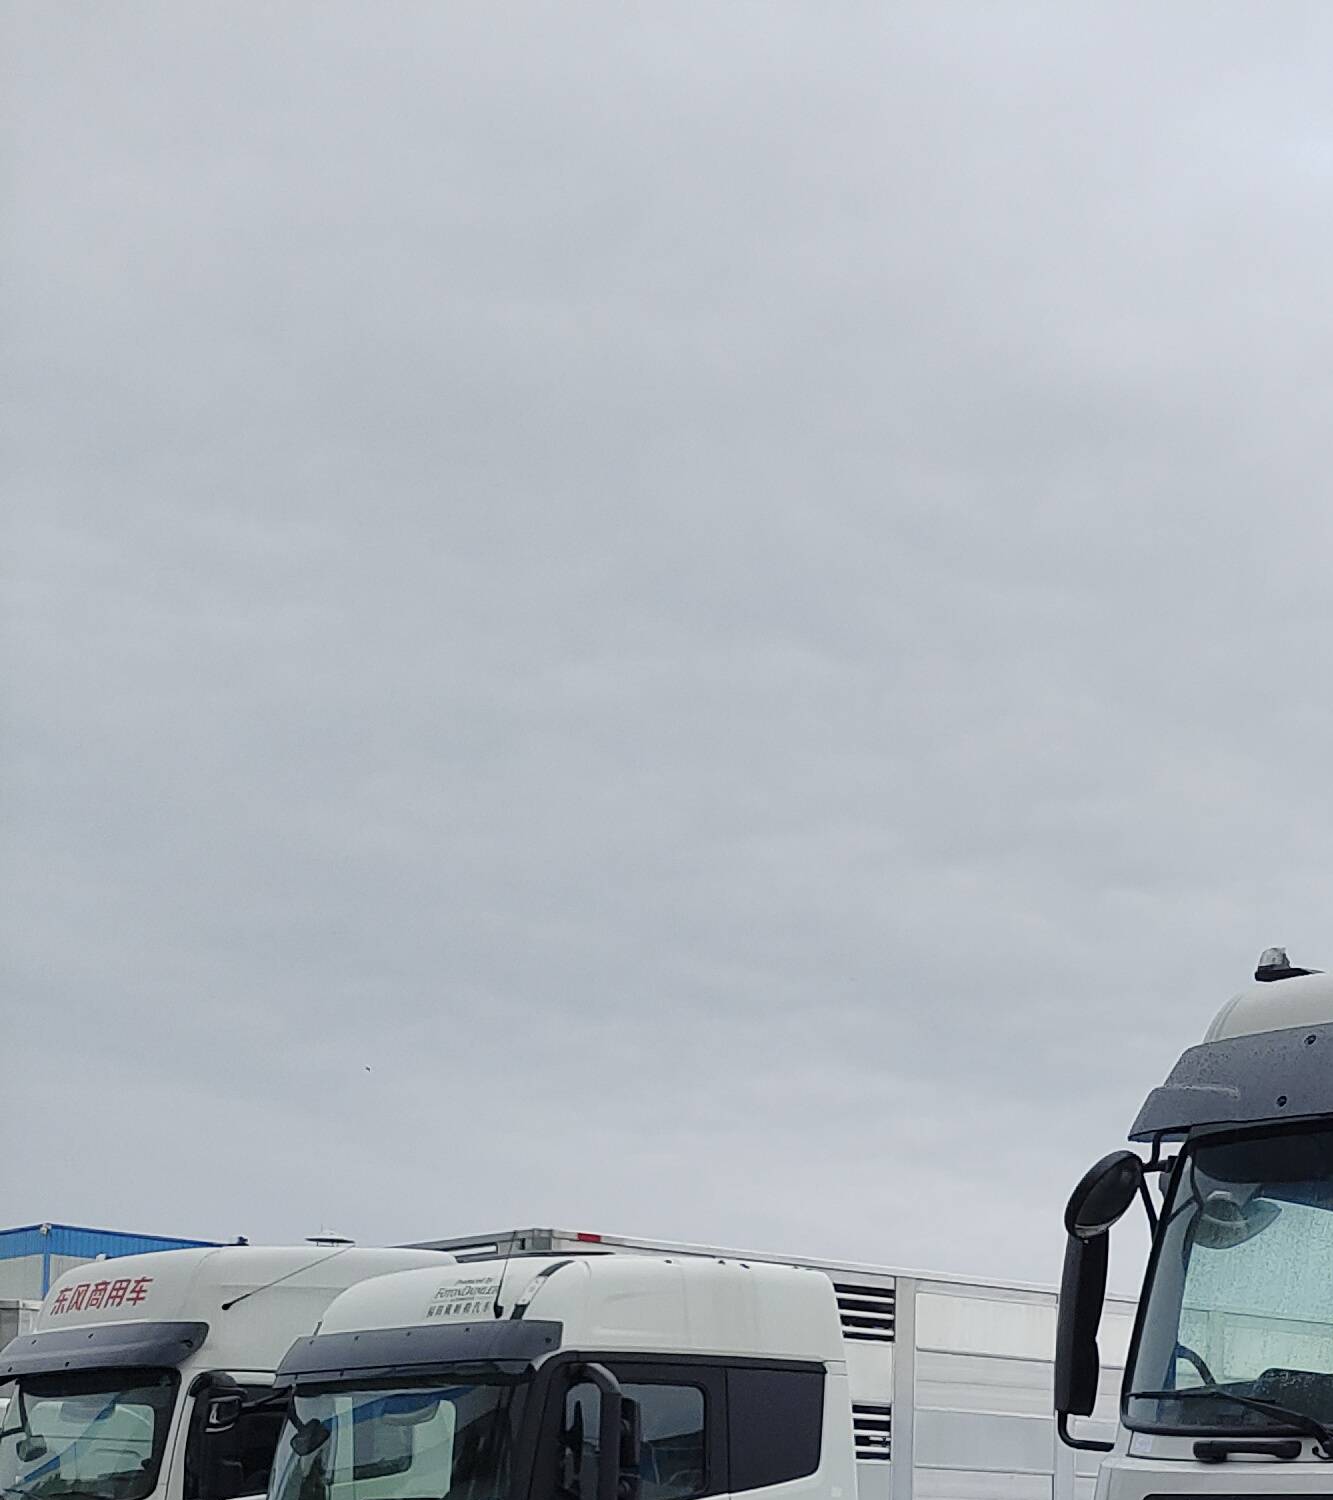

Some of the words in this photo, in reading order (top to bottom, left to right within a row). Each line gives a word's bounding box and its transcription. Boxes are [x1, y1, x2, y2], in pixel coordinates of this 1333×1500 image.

[50, 1276, 154, 1316] 东风商用车
